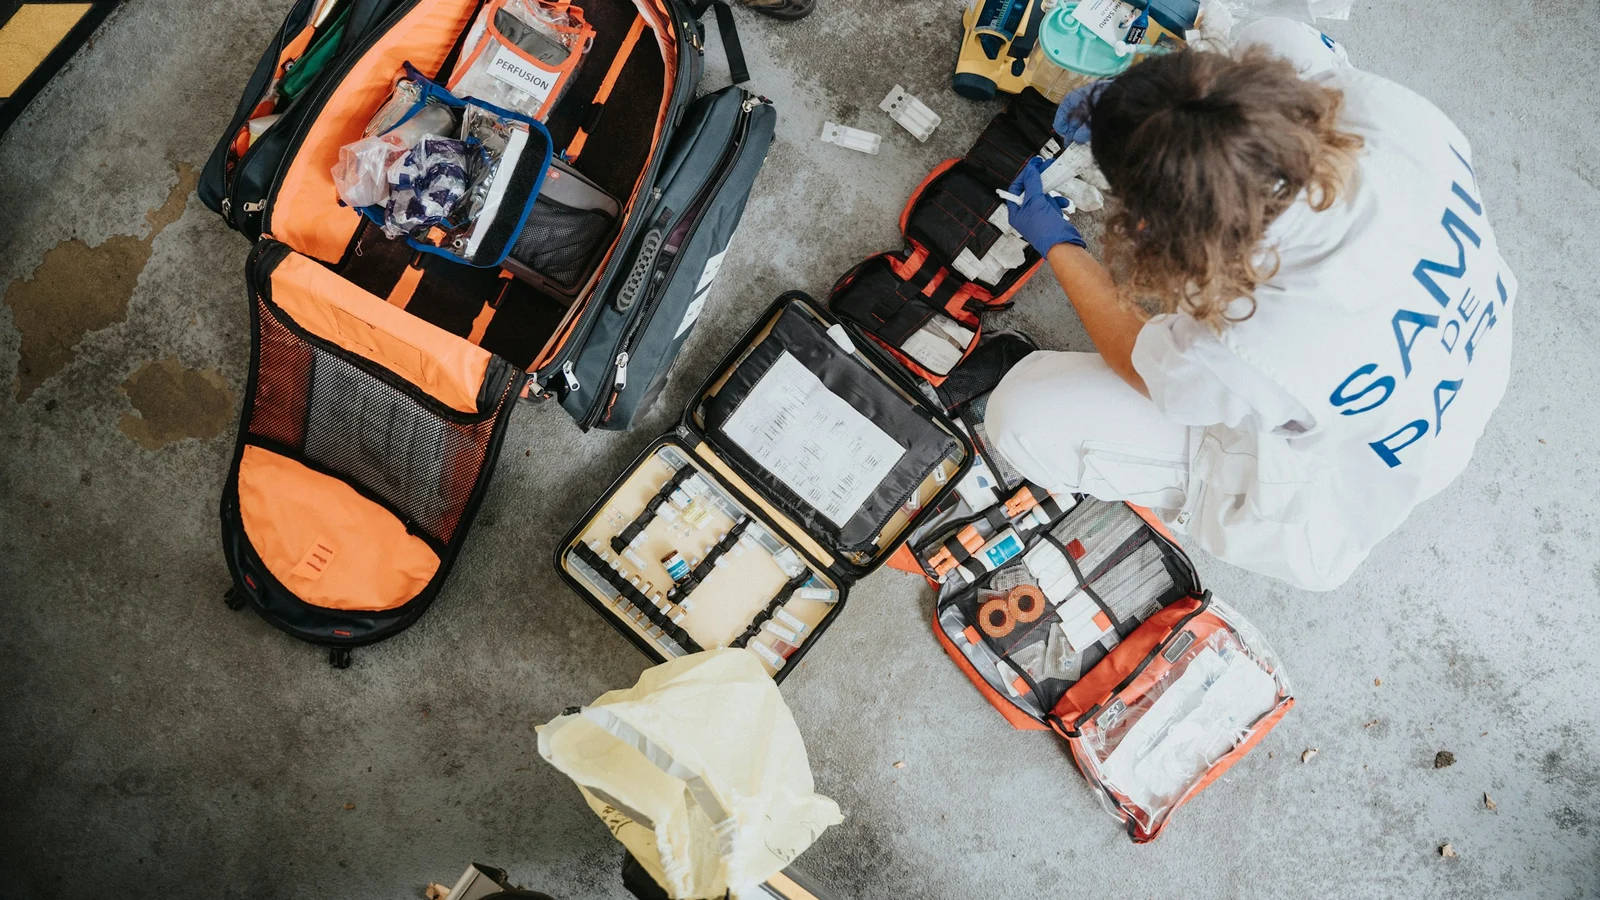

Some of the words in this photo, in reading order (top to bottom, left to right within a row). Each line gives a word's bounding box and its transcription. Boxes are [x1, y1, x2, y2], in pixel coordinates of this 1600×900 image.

[1099, 10, 1115, 29] SAMU
[495, 58, 549, 90] PERFUSION
[1440, 286, 1480, 355] DE
[1368, 271, 1508, 469] PARI
